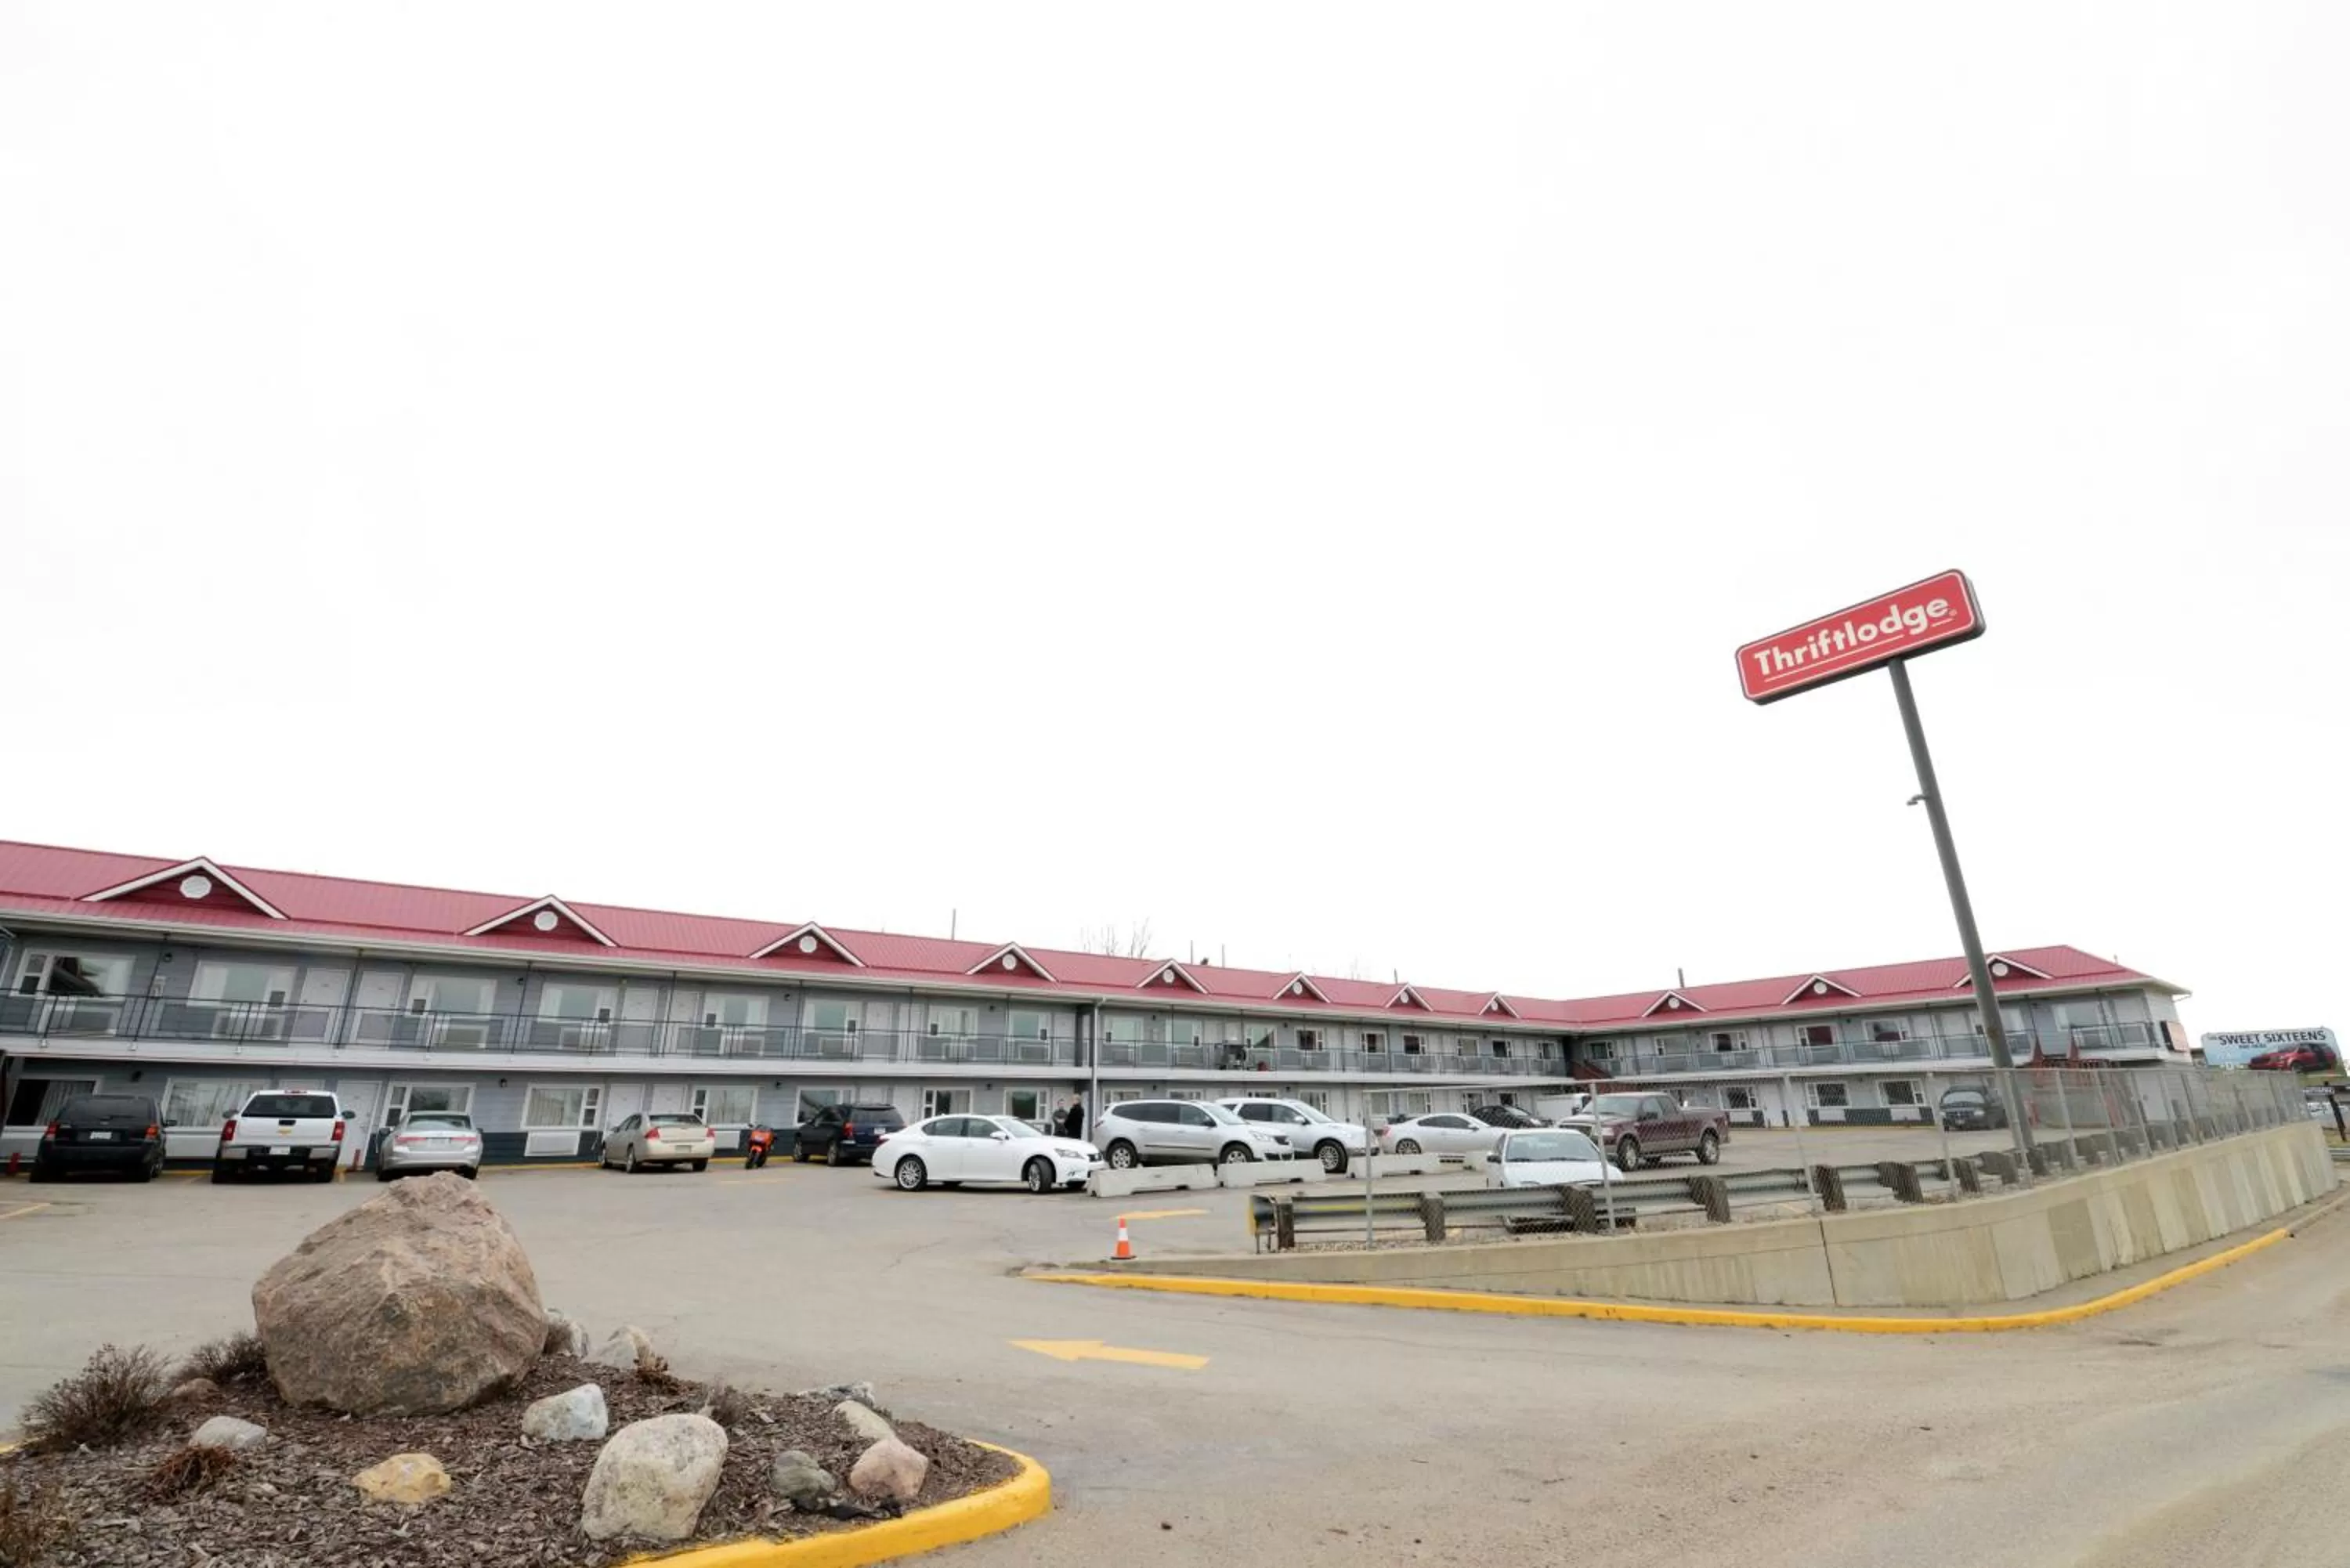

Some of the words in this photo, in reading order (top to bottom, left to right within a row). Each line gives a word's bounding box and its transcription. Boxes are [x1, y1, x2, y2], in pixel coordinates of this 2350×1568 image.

[1754, 598, 1949, 675] Thriftlodge
[2218, 1033, 2261, 1046] SWEET
[2264, 1030, 2326, 1042] SIXTEENS
